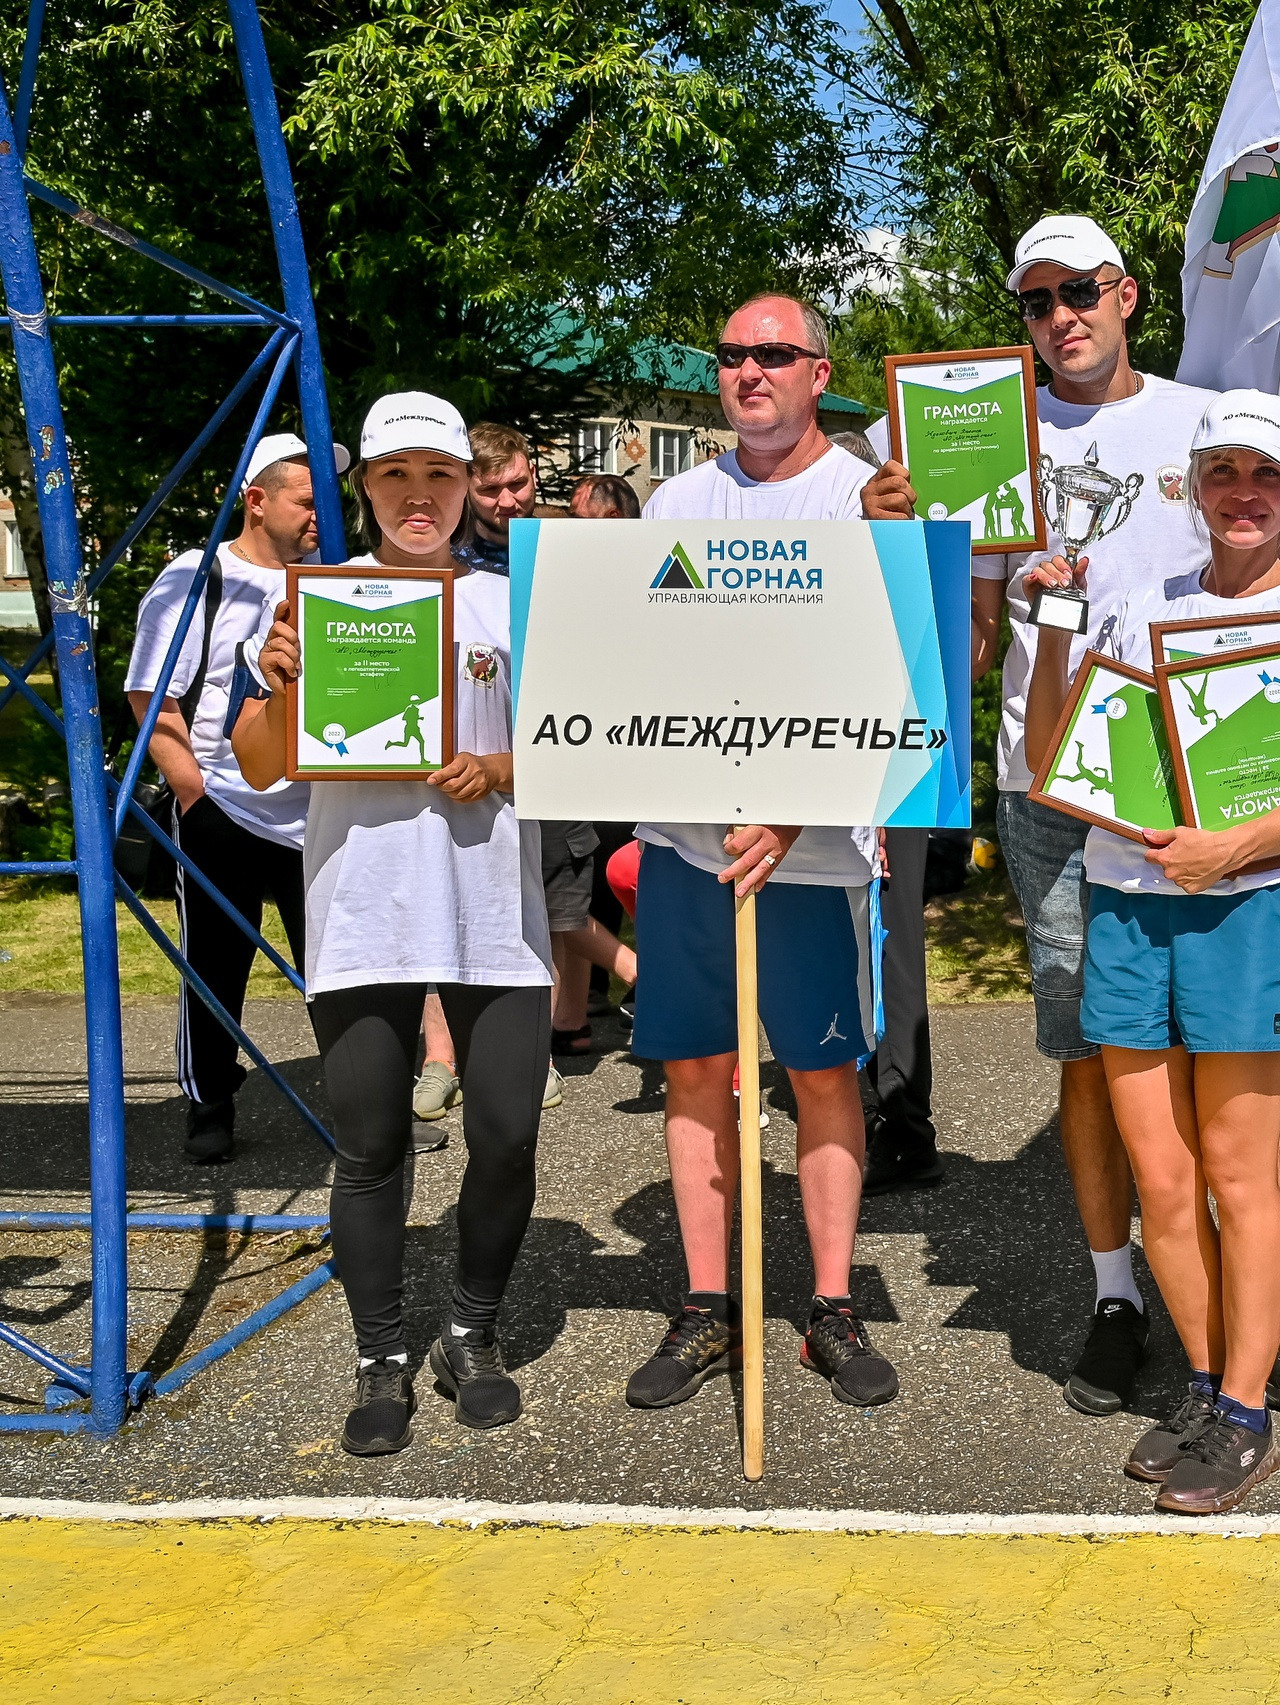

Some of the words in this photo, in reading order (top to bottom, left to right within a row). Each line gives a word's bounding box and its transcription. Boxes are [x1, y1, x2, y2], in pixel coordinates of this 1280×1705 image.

[924, 402, 1002, 420] ГРАМОТА
[940, 416, 988, 426] награждается
[706, 539, 807, 561] НОВАЯ
[706, 568, 822, 590] ГОРНАЯ
[648, 592, 747, 606] УПРАВЛЯЮЩАЯ
[750, 593, 824, 604] КОМПАНИЯ
[326, 622, 416, 637] ГРАМОТА
[531, 713, 593, 747] АО
[604, 714, 948, 757] «МЕЖДУРЕЧЬЕ»
